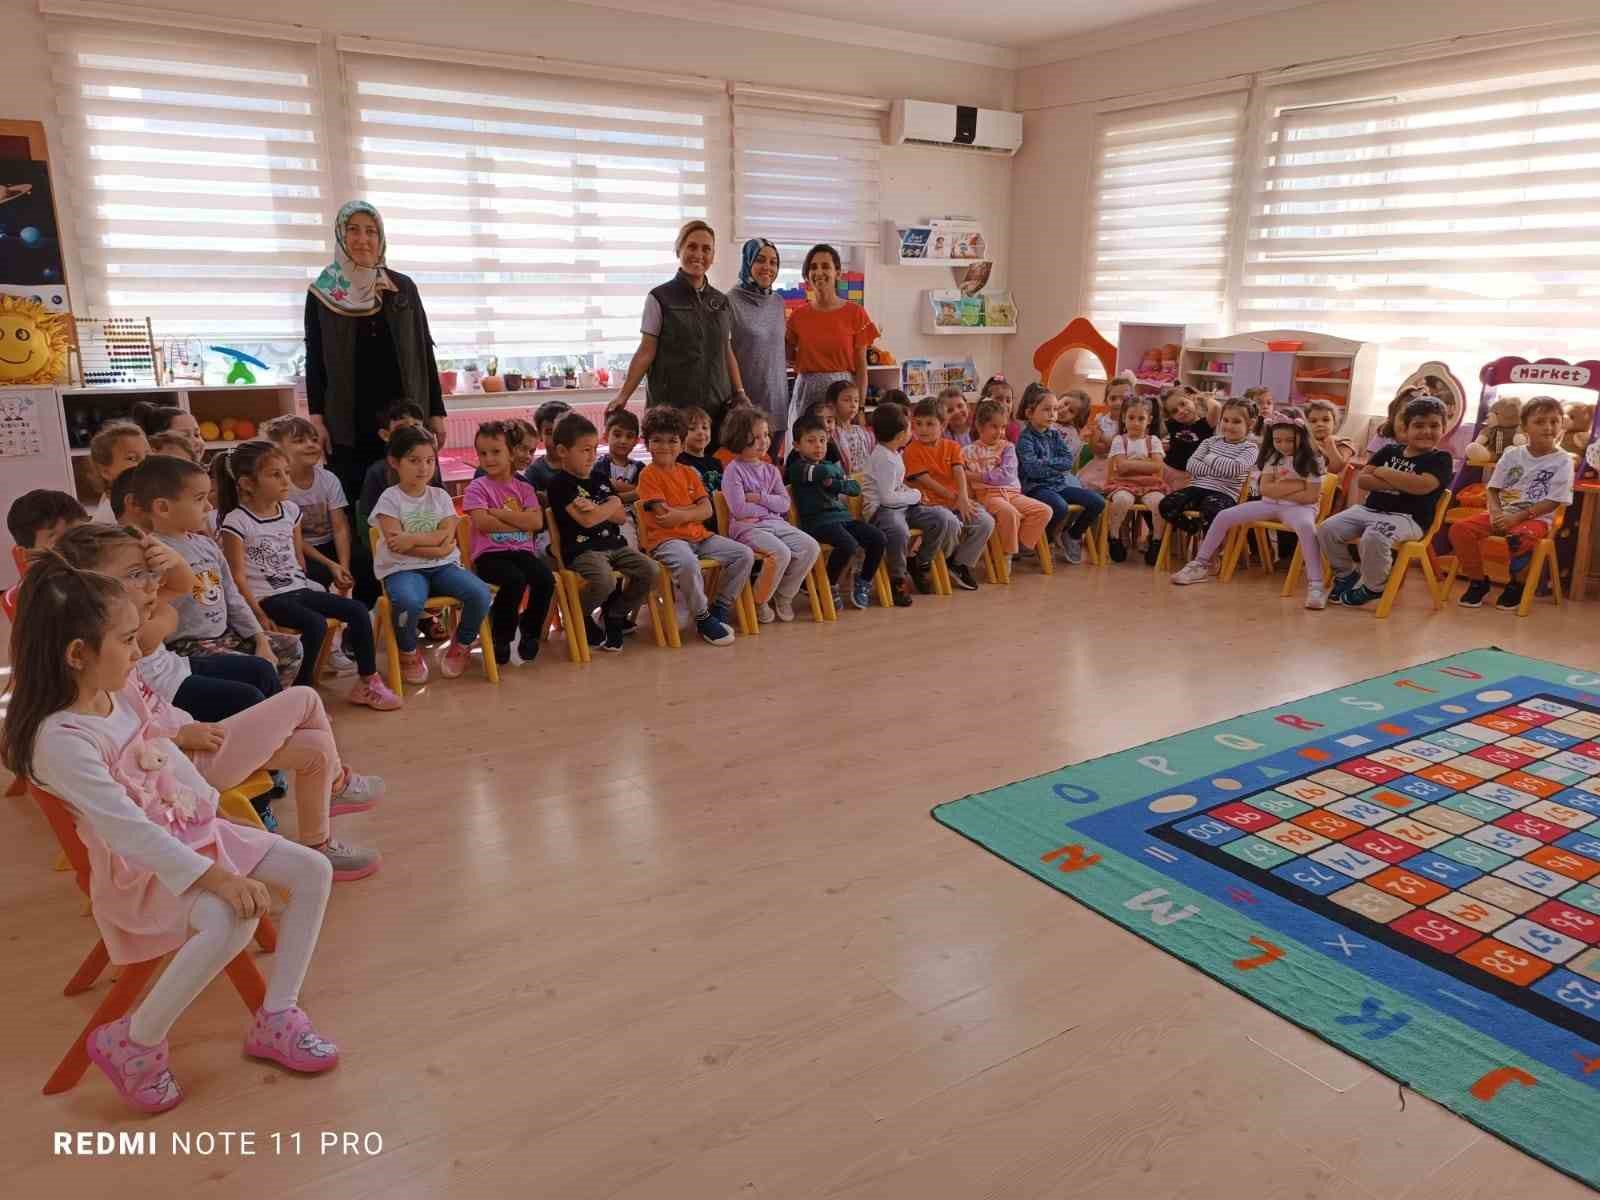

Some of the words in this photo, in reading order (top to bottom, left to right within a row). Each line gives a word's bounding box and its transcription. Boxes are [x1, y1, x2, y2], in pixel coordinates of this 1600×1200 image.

[1519, 368, 1582, 381] Market
[1394, 679, 1437, 693] T
[1340, 697, 1384, 712] S
[1274, 713, 1326, 731] R
[1214, 734, 1265, 751] Q
[1410, 747, 1442, 757] 93
[1136, 755, 1177, 776] P
[1354, 766, 1388, 777] 95
[1432, 771, 1467, 784] 82
[1052, 784, 1099, 804] O
[1295, 787, 1327, 800] 97
[1403, 781, 1439, 796] 83
[1259, 799, 1295, 812] 98
[1342, 804, 1380, 819] 84
[1544, 806, 1578, 821] 57
[1225, 811, 1263, 825] 99
[1311, 816, 1348, 832] 85
[1187, 821, 1232, 840] 100
[1395, 824, 1436, 841] 72
[1513, 819, 1552, 835] 58
[1276, 829, 1314, 845] 86
[1486, 832, 1523, 848] 59
[1245, 843, 1278, 862] 87
[1364, 838, 1404, 855] 73
[1040, 843, 1102, 874] N
[1329, 852, 1370, 871] 74
[1546, 855, 1583, 871] 46
[1293, 866, 1335, 886] 75
[1421, 861, 1459, 879] 61
[1385, 876, 1428, 894] 62
[1520, 870, 1553, 888] 47
[1122, 887, 1201, 927] M
[1448, 903, 1490, 922] 49
[1549, 911, 1595, 932] 36
[1413, 919, 1459, 942] 50
[1519, 929, 1563, 954] 37
[1232, 935, 1287, 971] L
[1481, 950, 1529, 974] 38
[1556, 980, 1600, 1009] 25
[1334, 997, 1411, 1041] K
